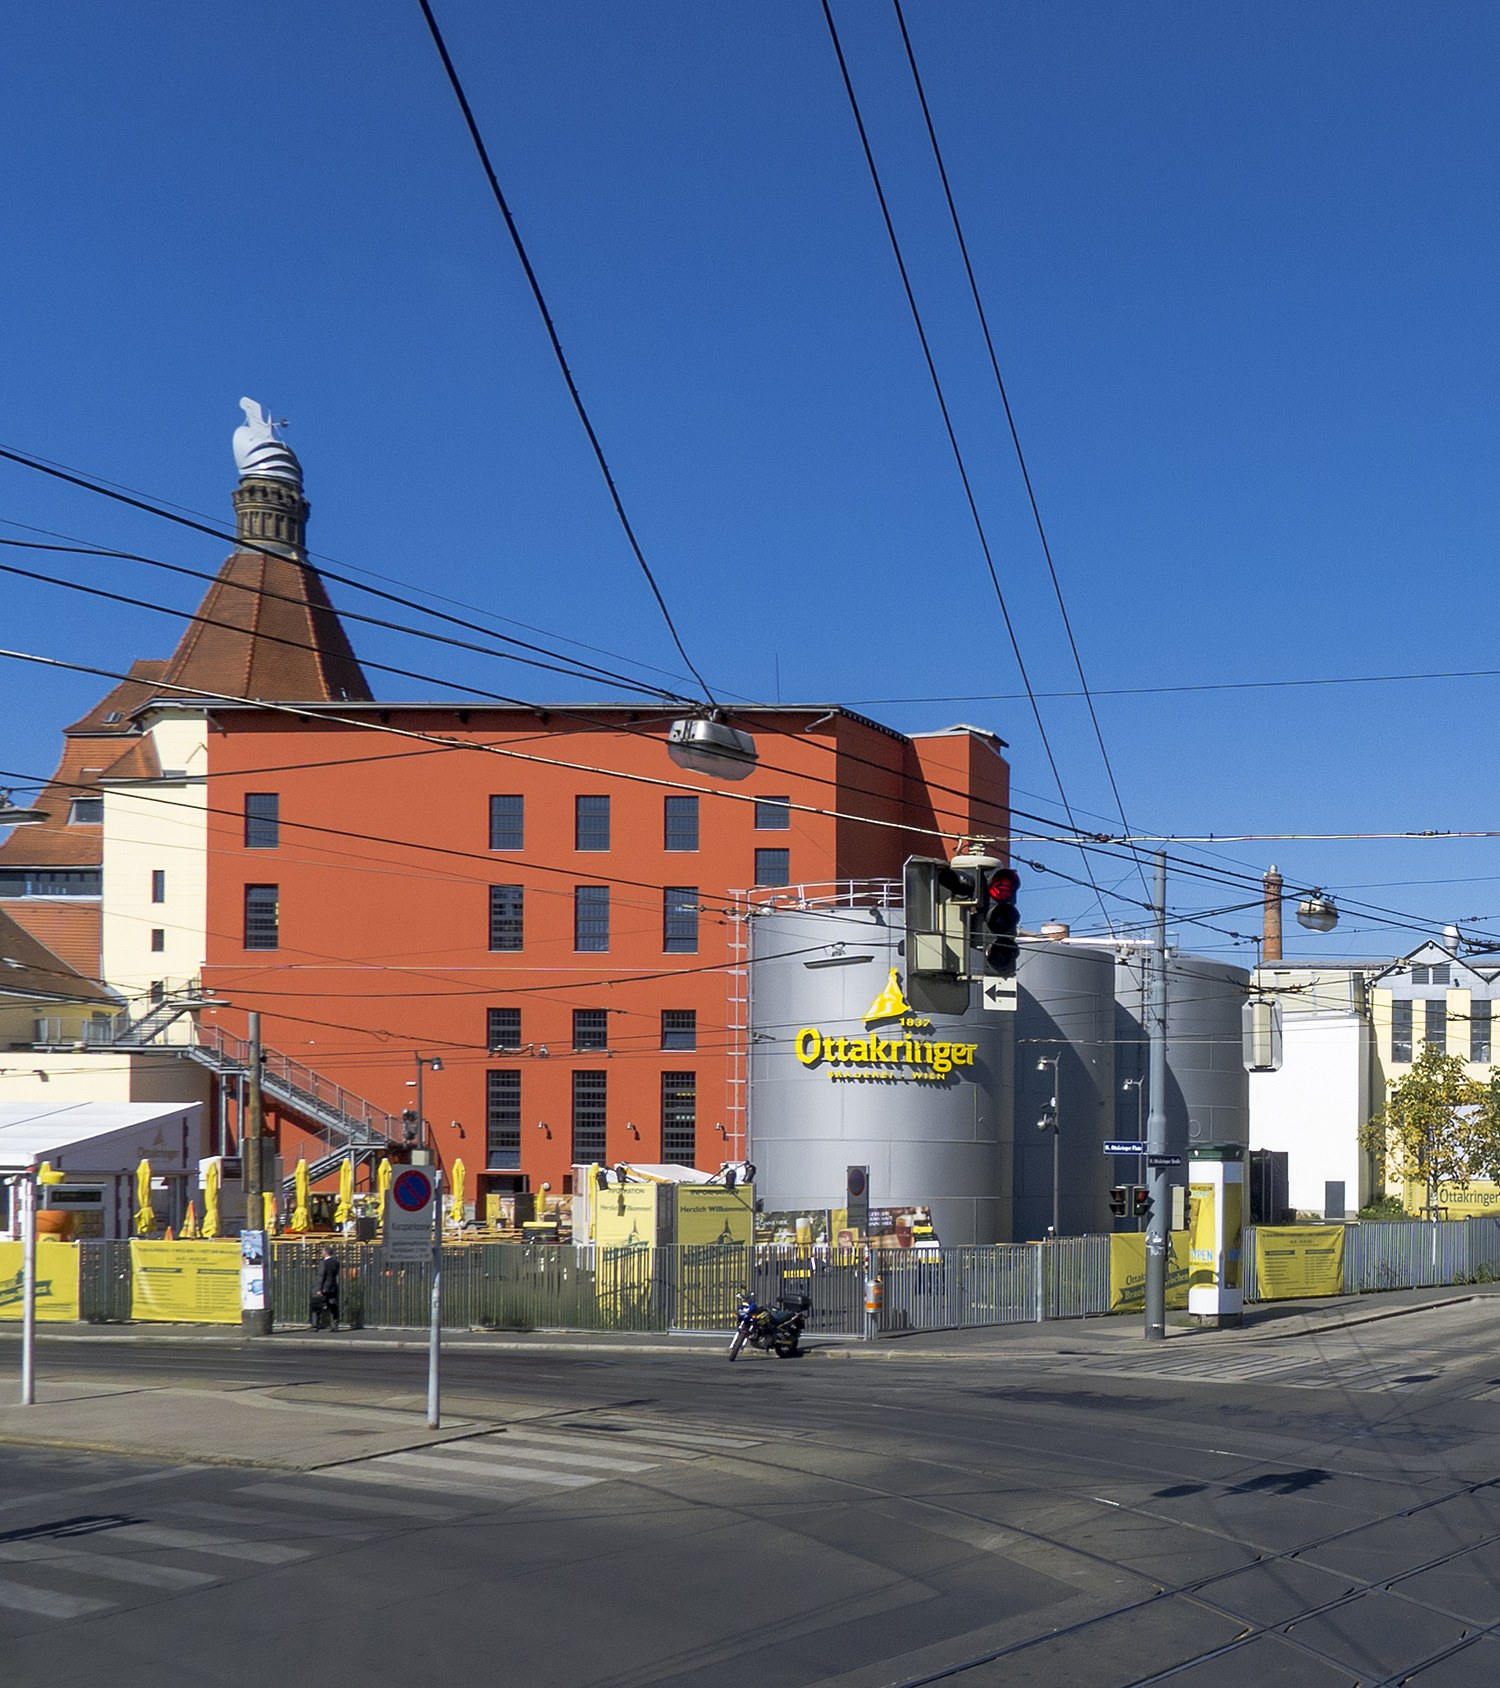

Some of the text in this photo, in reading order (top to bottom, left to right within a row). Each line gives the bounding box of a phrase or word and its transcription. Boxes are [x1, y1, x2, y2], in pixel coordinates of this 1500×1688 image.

[899, 1017, 931, 1028] 1837
[795, 1027, 978, 1072] Ottakringer
[911, 1073, 946, 1081] WIEN
[1439, 1188, 1500, 1207] Ottakringer
[680, 1205, 707, 1213] Herzlich
